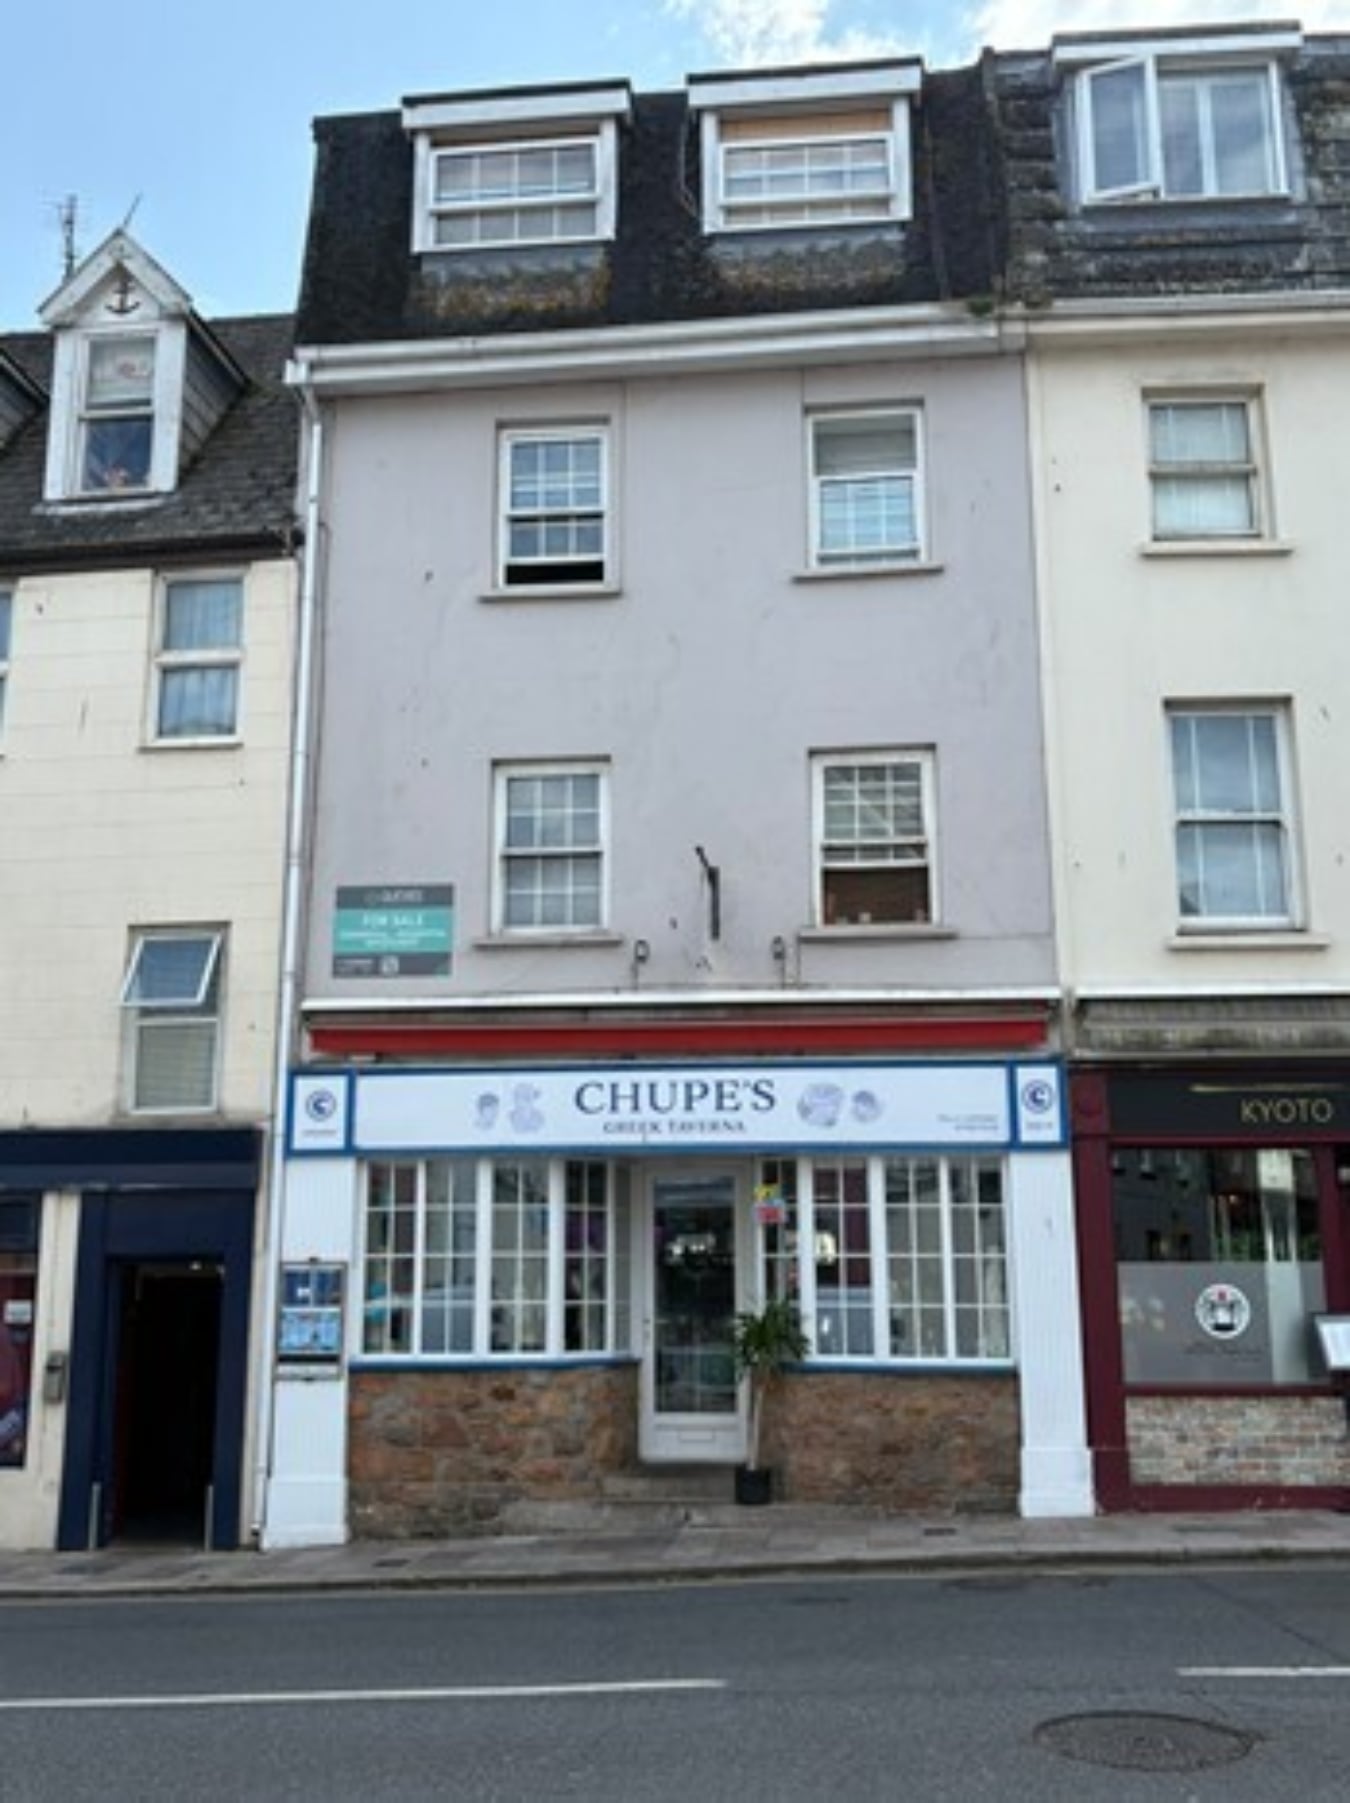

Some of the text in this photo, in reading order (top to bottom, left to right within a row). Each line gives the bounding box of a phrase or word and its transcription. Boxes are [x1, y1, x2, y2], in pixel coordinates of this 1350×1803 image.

[575, 1078, 776, 1114] CHUPE'S
[1240, 1098, 1334, 1123] KYOTO
[602, 1119, 746, 1133] GREEK TAVERNA
